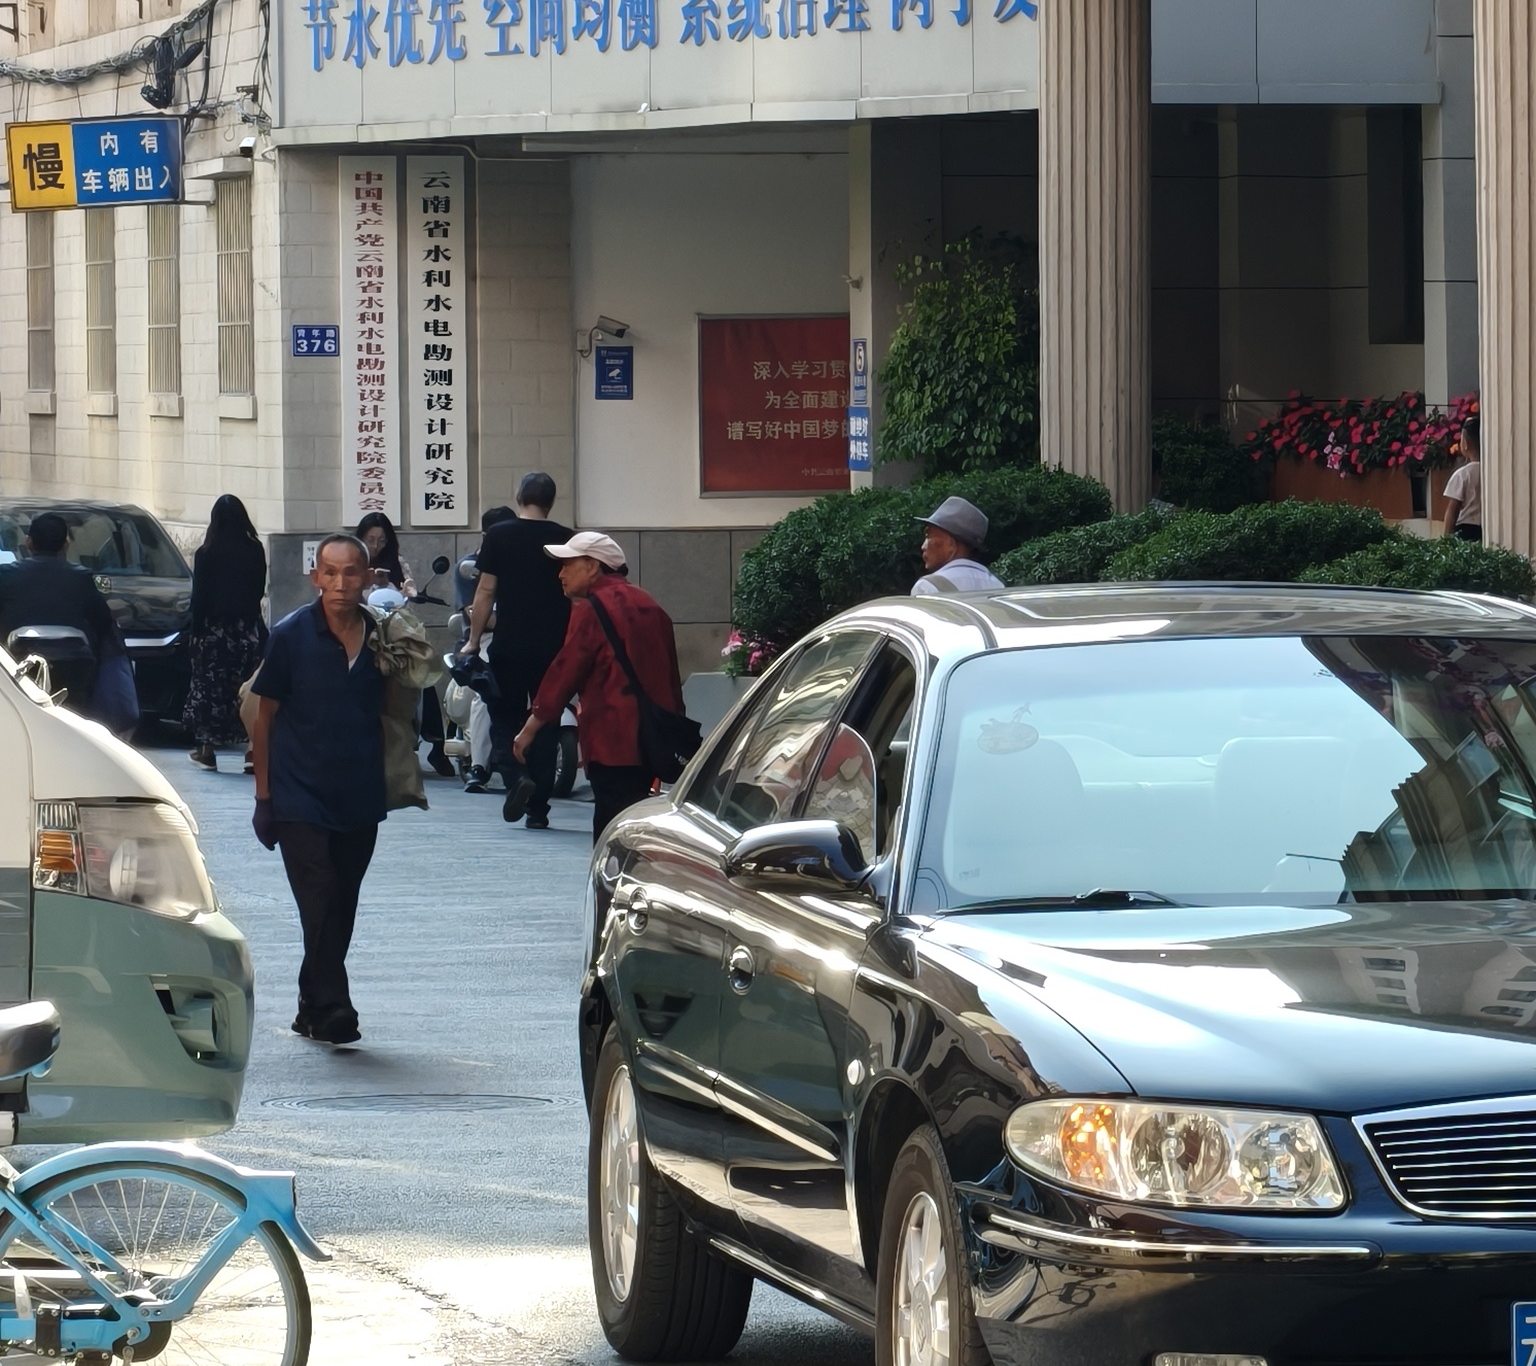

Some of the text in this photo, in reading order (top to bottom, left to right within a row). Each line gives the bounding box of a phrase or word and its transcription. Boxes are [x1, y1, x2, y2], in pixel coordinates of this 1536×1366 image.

[100, 129, 159, 157] 内有
[23, 142, 66, 192] 慢
[297, 338, 336, 353] 376
[354, 170, 387, 511] 中国共产党云南省水利水电勘测设计研究院委员会
[420, 170, 455, 511] 云南省水利水电勘测设计研究院
[753, 360, 850, 380] 深入学习贯
